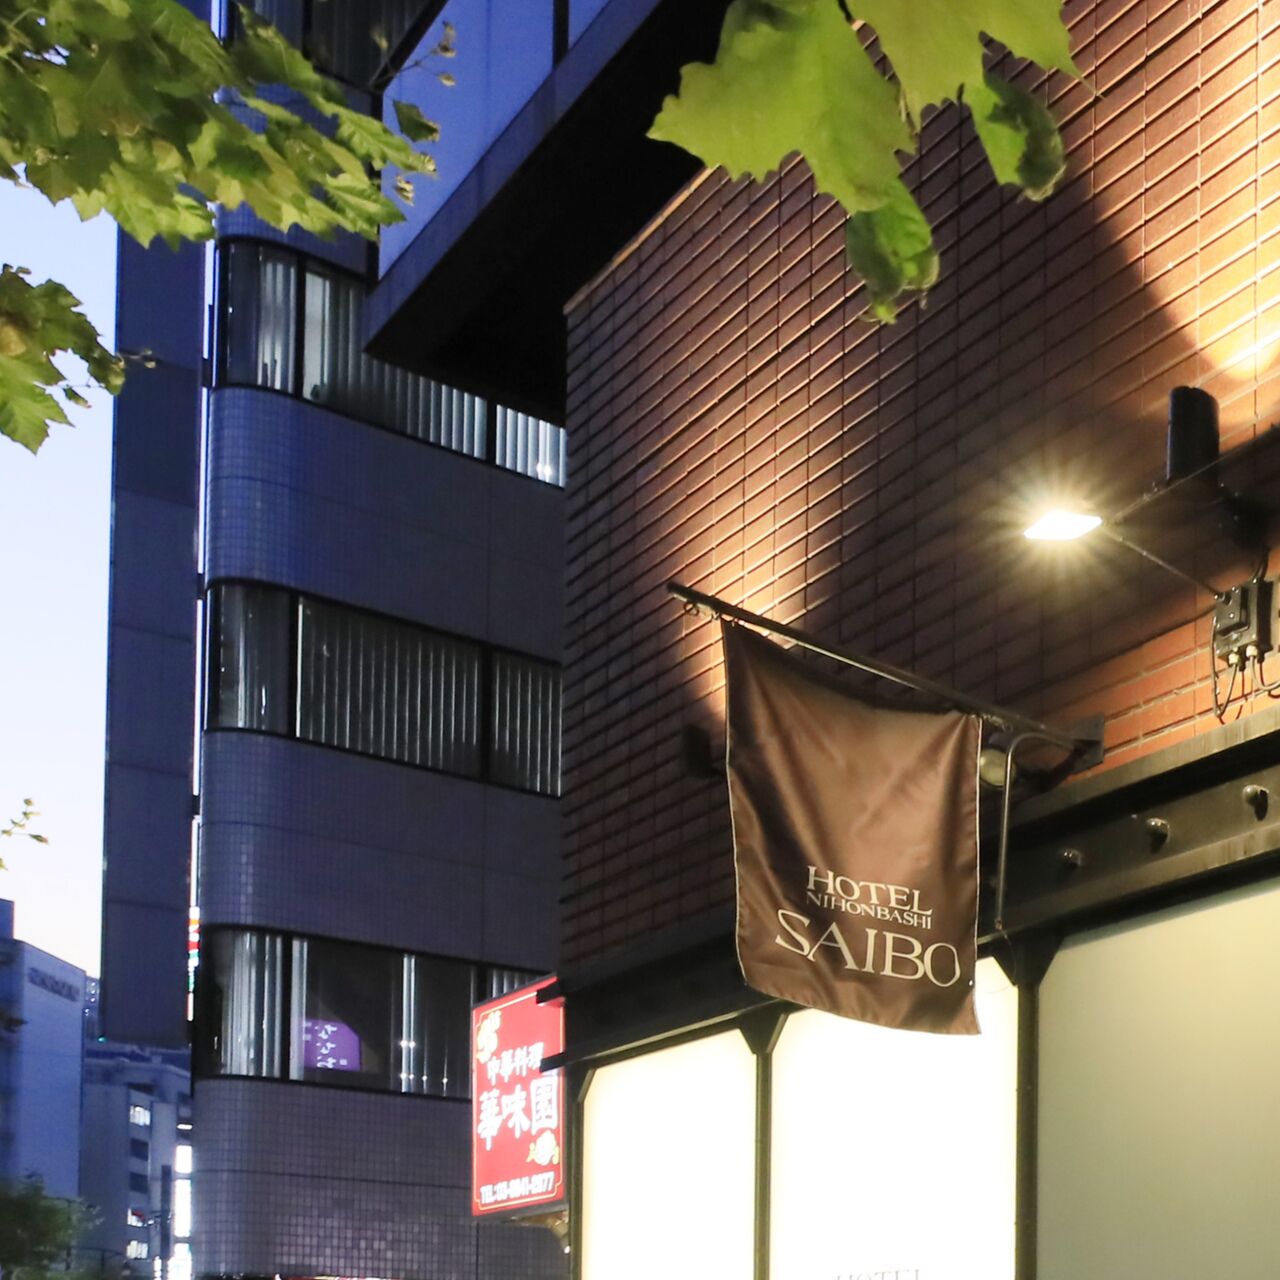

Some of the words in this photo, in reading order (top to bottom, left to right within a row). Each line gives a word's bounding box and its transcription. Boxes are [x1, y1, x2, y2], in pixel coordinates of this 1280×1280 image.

[806, 891, 932, 929] NIHONBASHI
[807, 866, 933, 915] HOTEL
[775, 909, 961, 987] SAIBO
[487, 1042, 544, 1086] 中華料理
